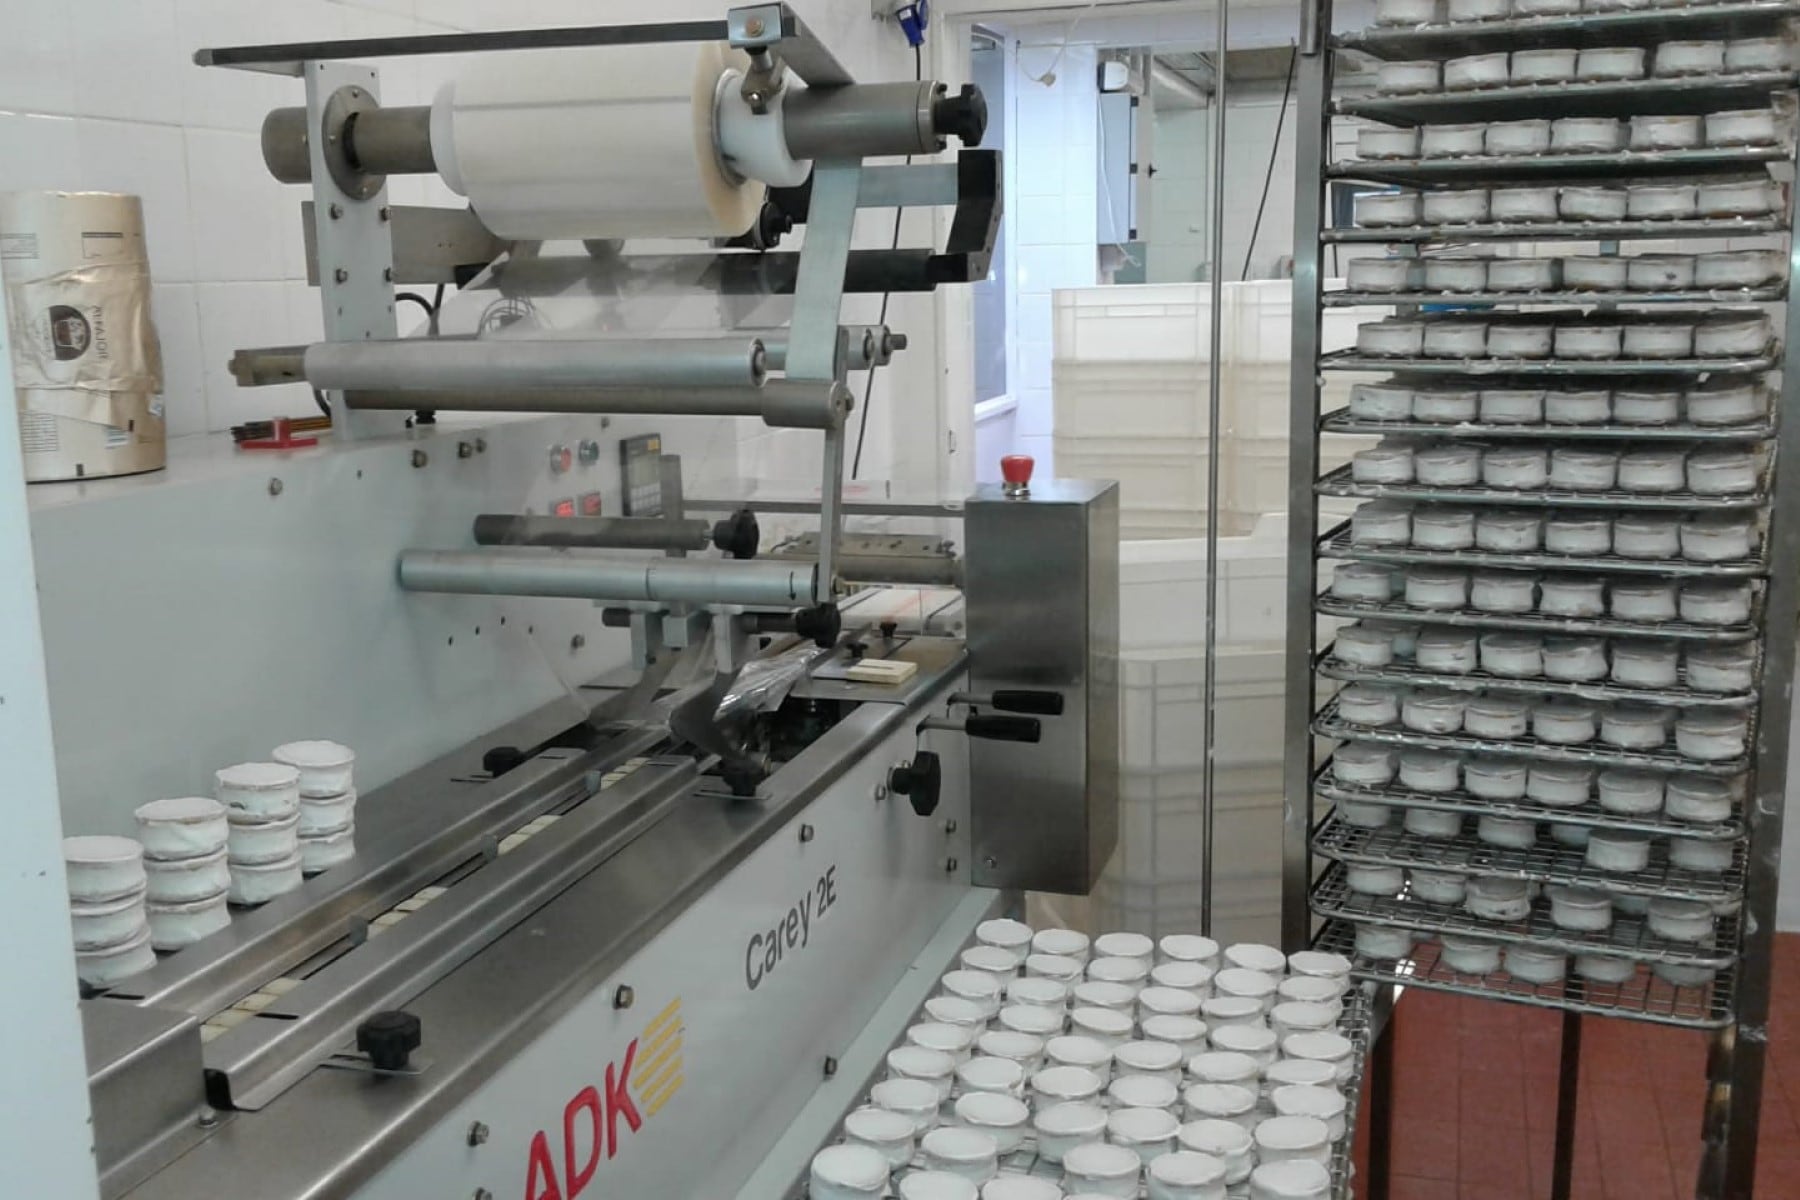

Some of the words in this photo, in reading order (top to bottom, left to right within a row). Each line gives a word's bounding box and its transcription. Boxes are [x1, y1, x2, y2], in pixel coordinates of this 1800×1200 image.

[746, 890, 811, 990] Carey
[816, 864, 837, 918] 2E
[525, 1037, 642, 1200] ADK
